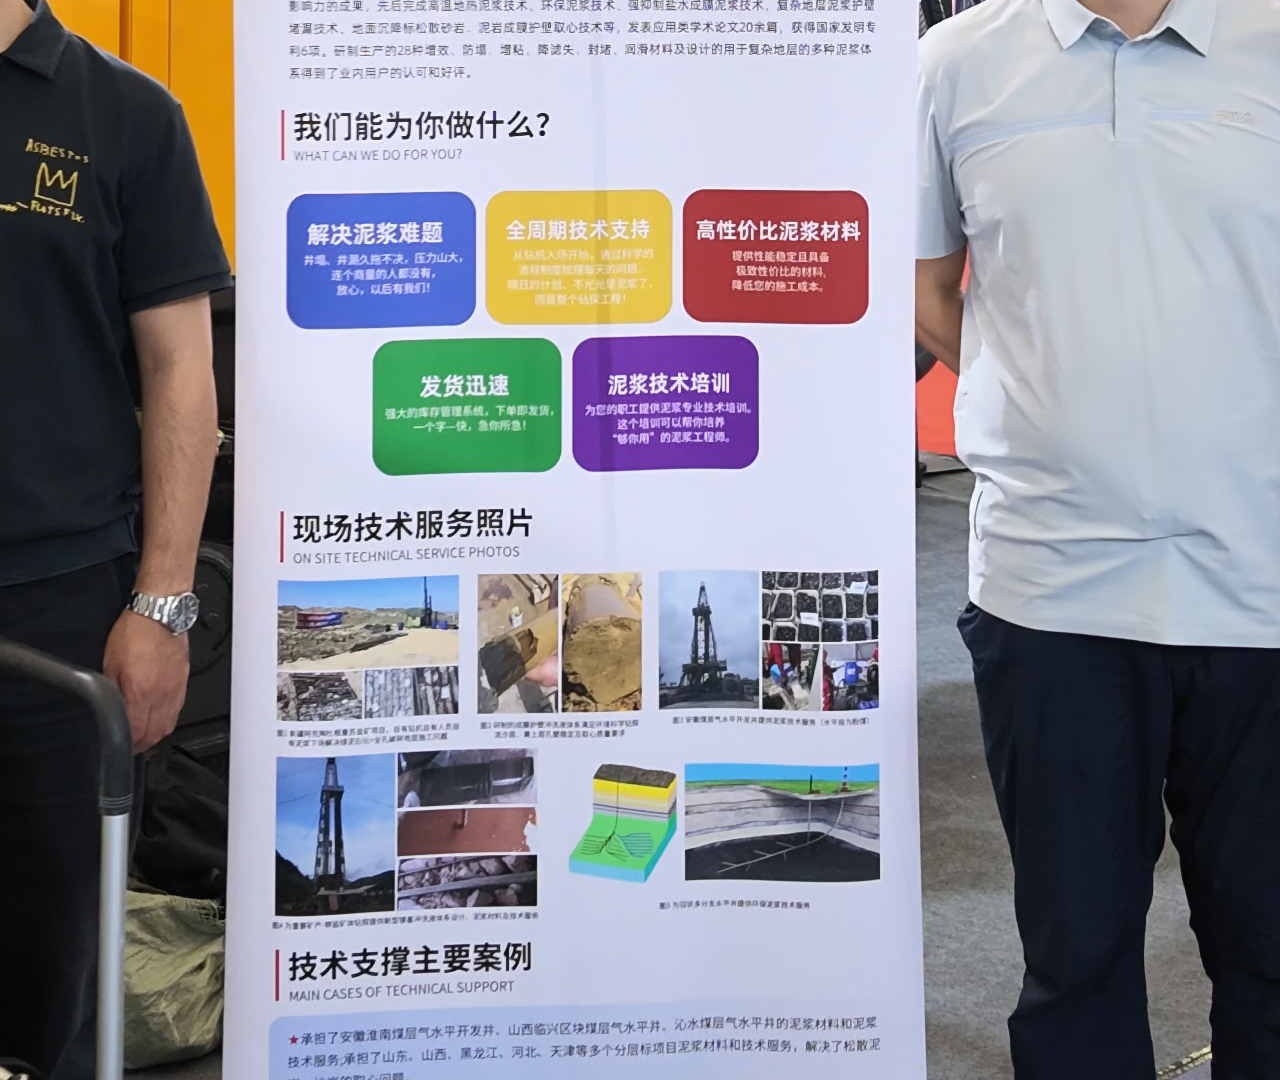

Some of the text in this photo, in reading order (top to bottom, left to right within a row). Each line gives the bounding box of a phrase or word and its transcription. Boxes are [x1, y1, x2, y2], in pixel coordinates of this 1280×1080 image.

[288, 66, 473, 80] 系得到了业内用户的认可和好评。
[294, 148, 463, 162] WHAT CAN WE DO FOR YOU?
[307, 221, 444, 246] 解决泥浆难题
[506, 219, 651, 241] 全周期技术支持
[696, 219, 862, 242] 高性价比泥浆材料
[420, 373, 510, 398] 发货迅速
[608, 372, 731, 395] 泥浆技术培训
[293, 508, 533, 543] 现场技术服务照片
[293, 546, 520, 564] ON SITE TECHNICAL SERVICE PHOTOS
[288, 941, 532, 981] 技术支撑主要案例
[289, 980, 515, 1002] MAIN CASES OF TECHNICAL SUPPORT
